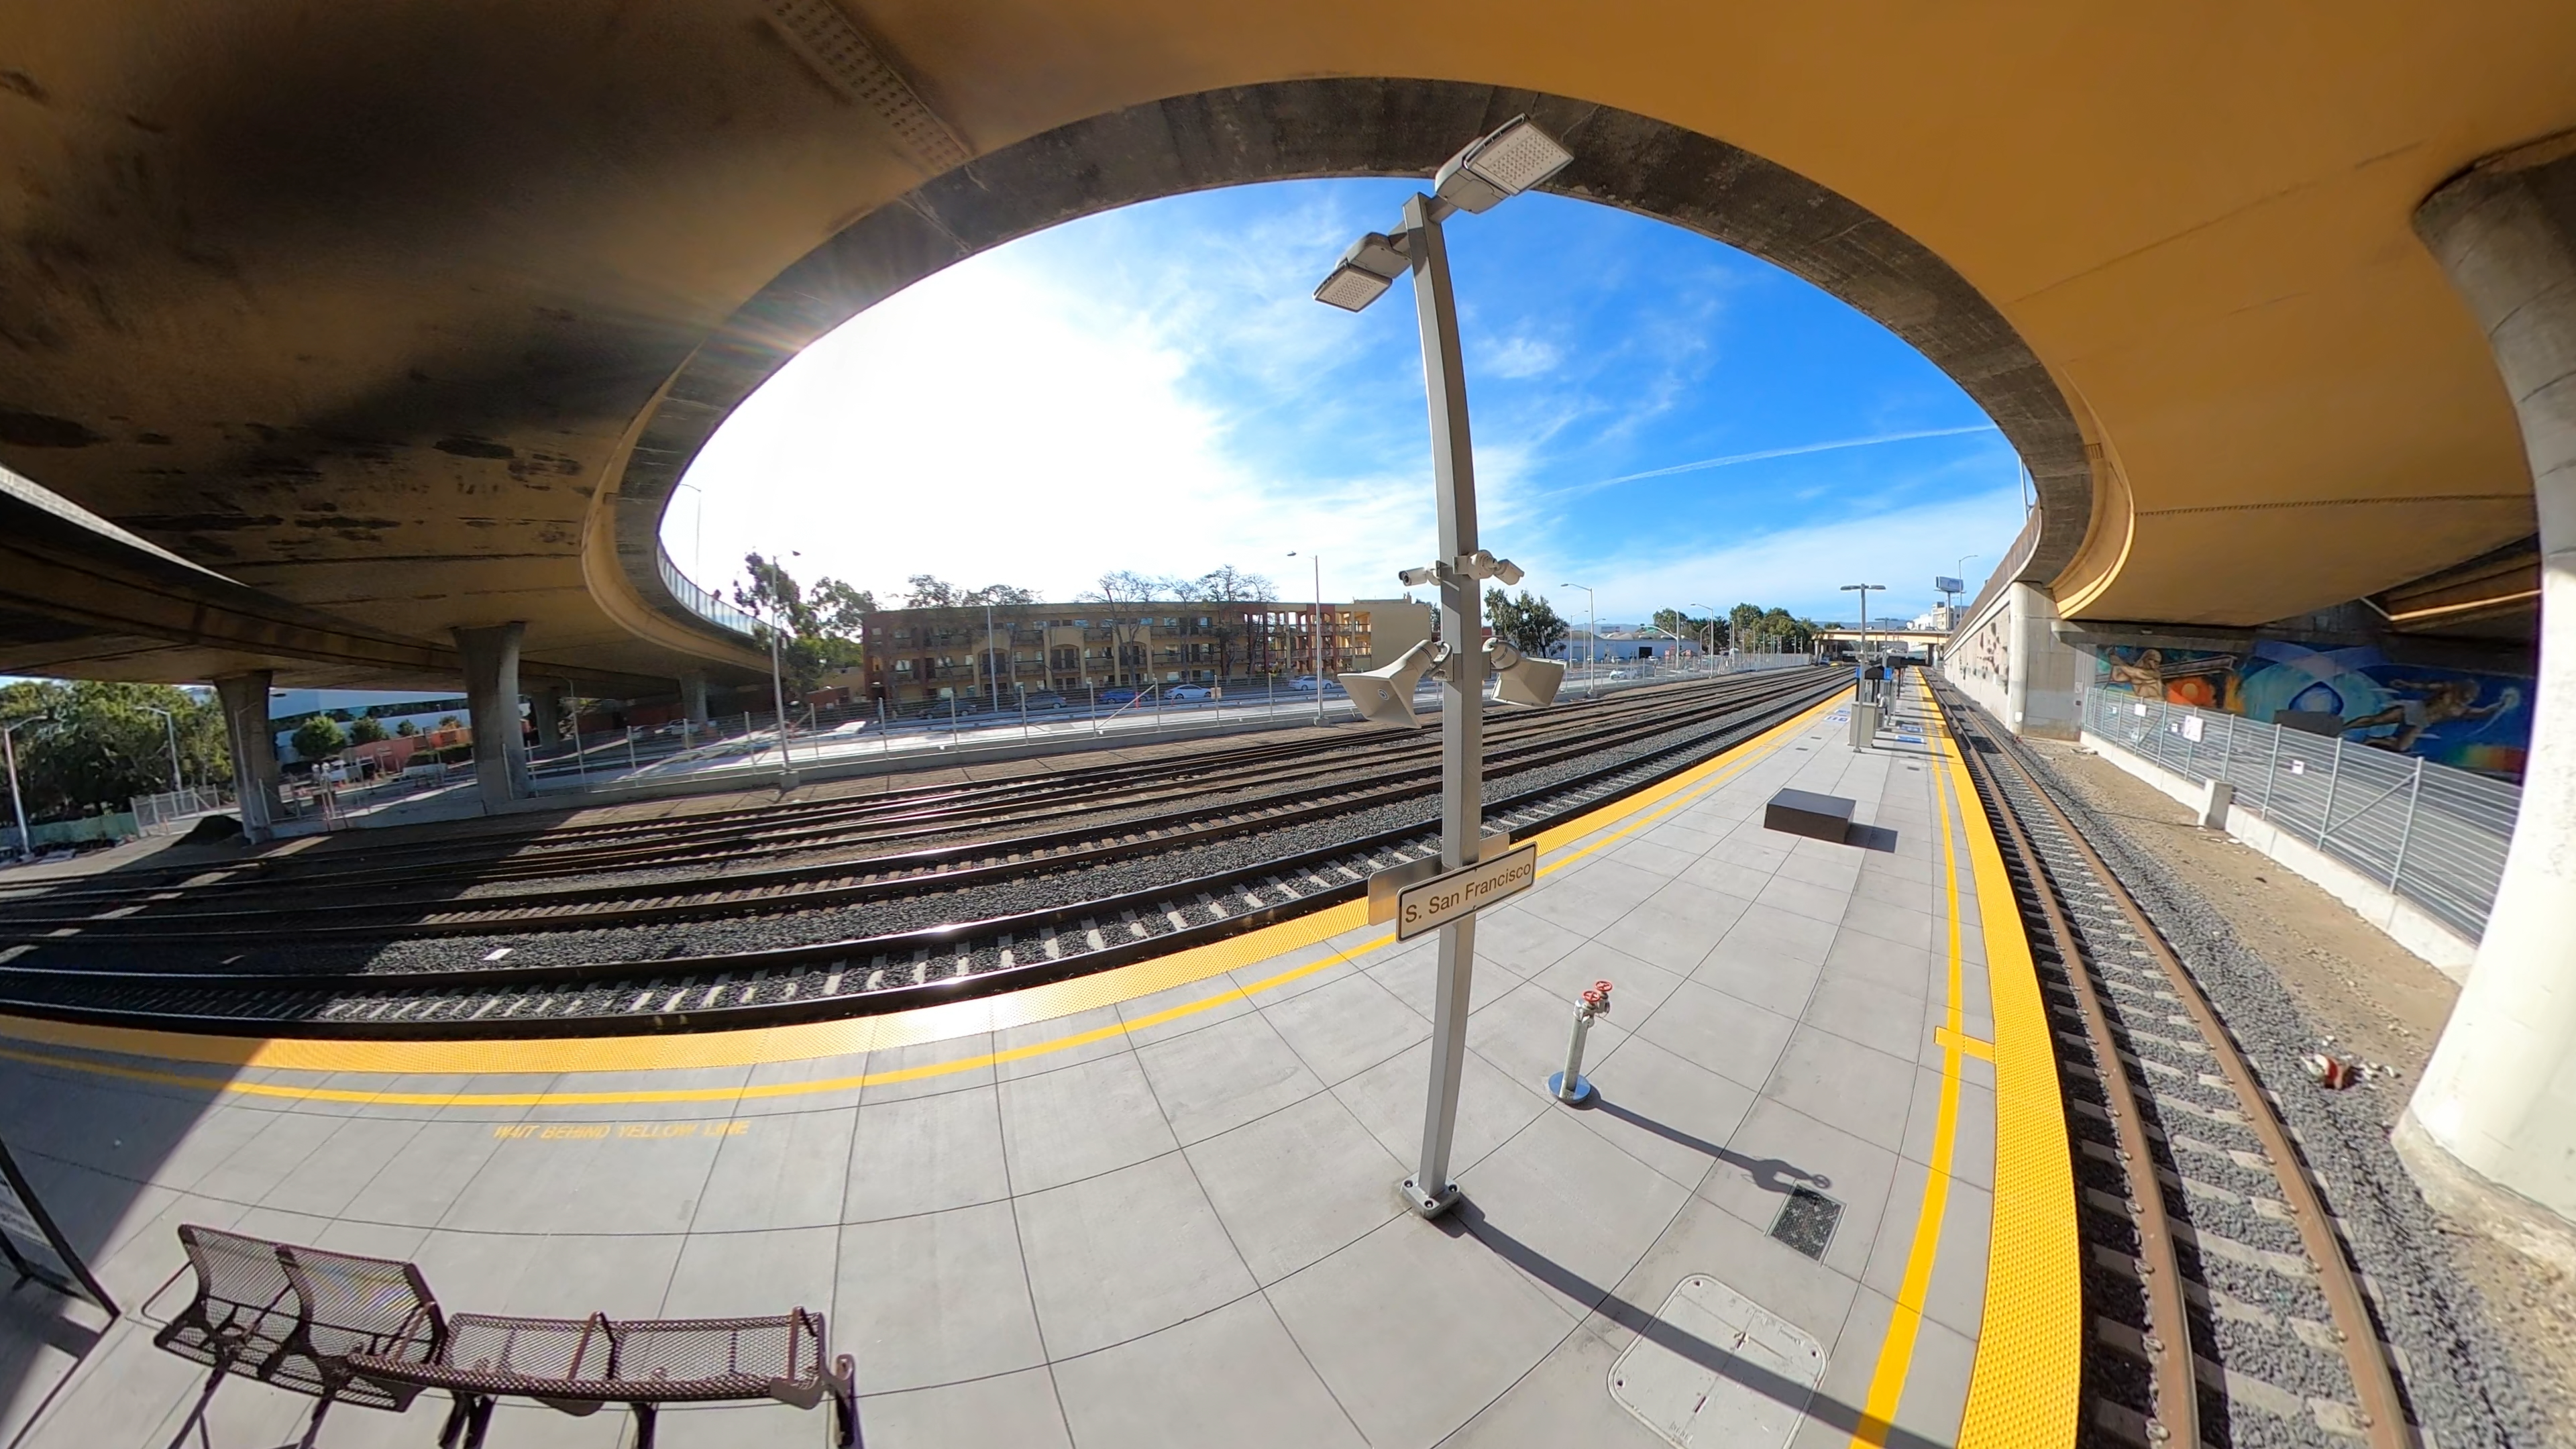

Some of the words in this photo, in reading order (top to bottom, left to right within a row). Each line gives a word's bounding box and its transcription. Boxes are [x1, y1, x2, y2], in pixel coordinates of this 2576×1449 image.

[1405, 904, 1422, 923] S.
[1429, 893, 1459, 914] San
[1465, 863, 1531, 900] Francisco
[494, 1125, 539, 1138] WAIT
[541, 1125, 610, 1139] BEHIND
[619, 1123, 698, 1138] YELLOW
[704, 1121, 751, 1136] LINE
